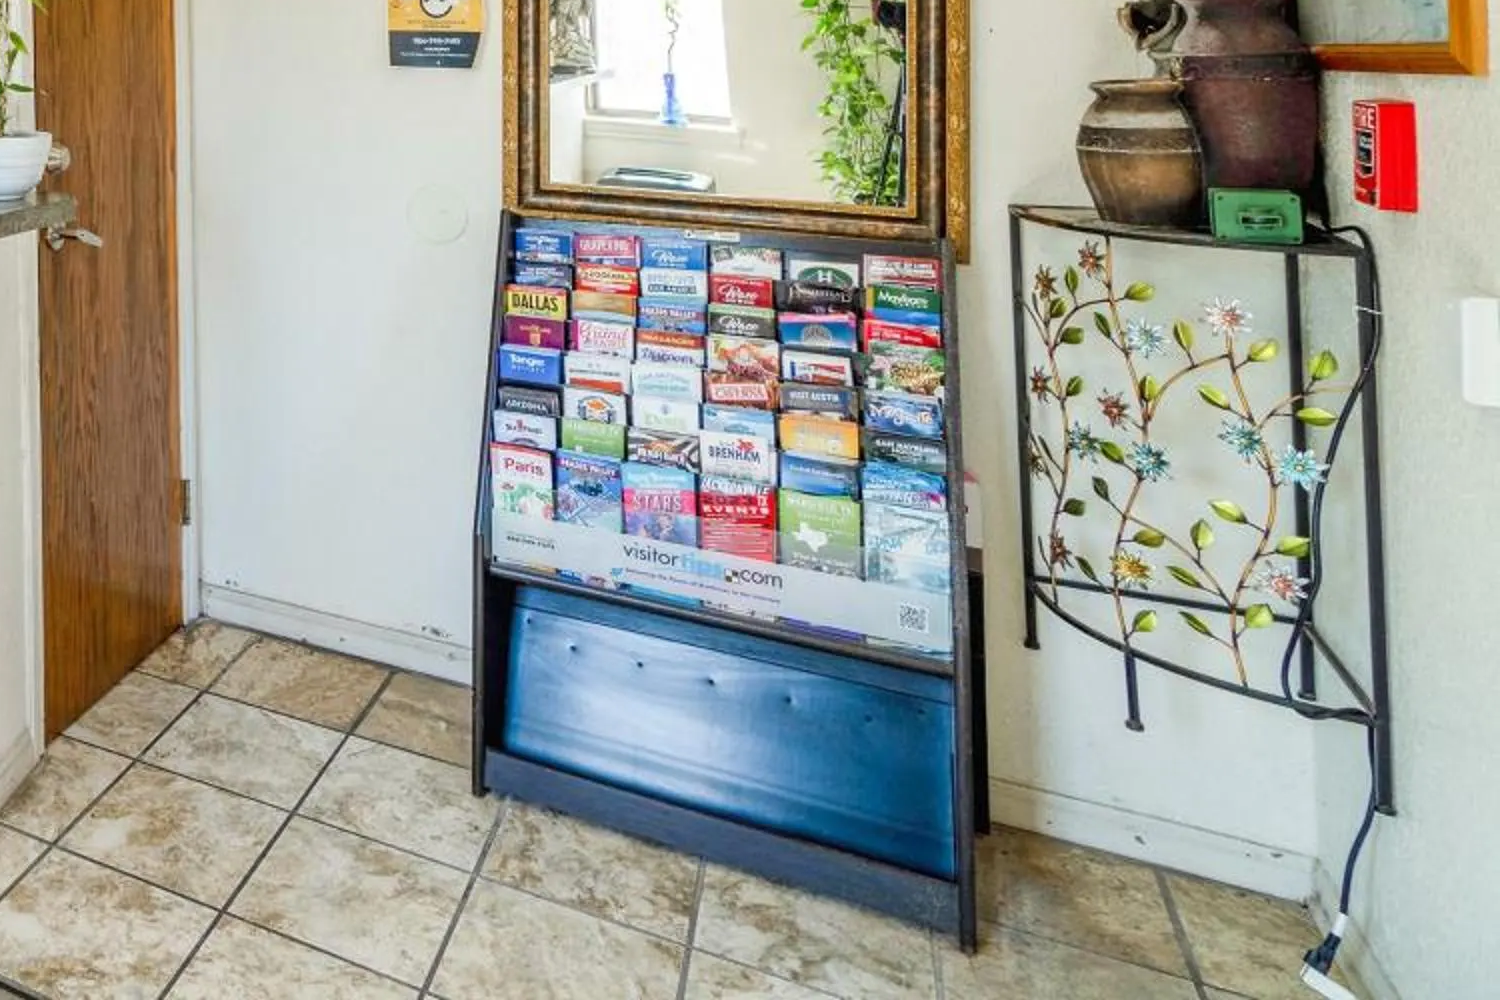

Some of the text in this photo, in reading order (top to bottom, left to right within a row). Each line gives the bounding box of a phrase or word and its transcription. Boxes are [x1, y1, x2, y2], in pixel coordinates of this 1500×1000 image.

[512, 293, 558, 312] DALLAS
[510, 353, 546, 367] Tanger
[708, 445, 761, 464] BRENHAM
[505, 456, 545, 476] Paris
[632, 494, 681, 513] STARS
[702, 504, 770, 515] EVENTS
